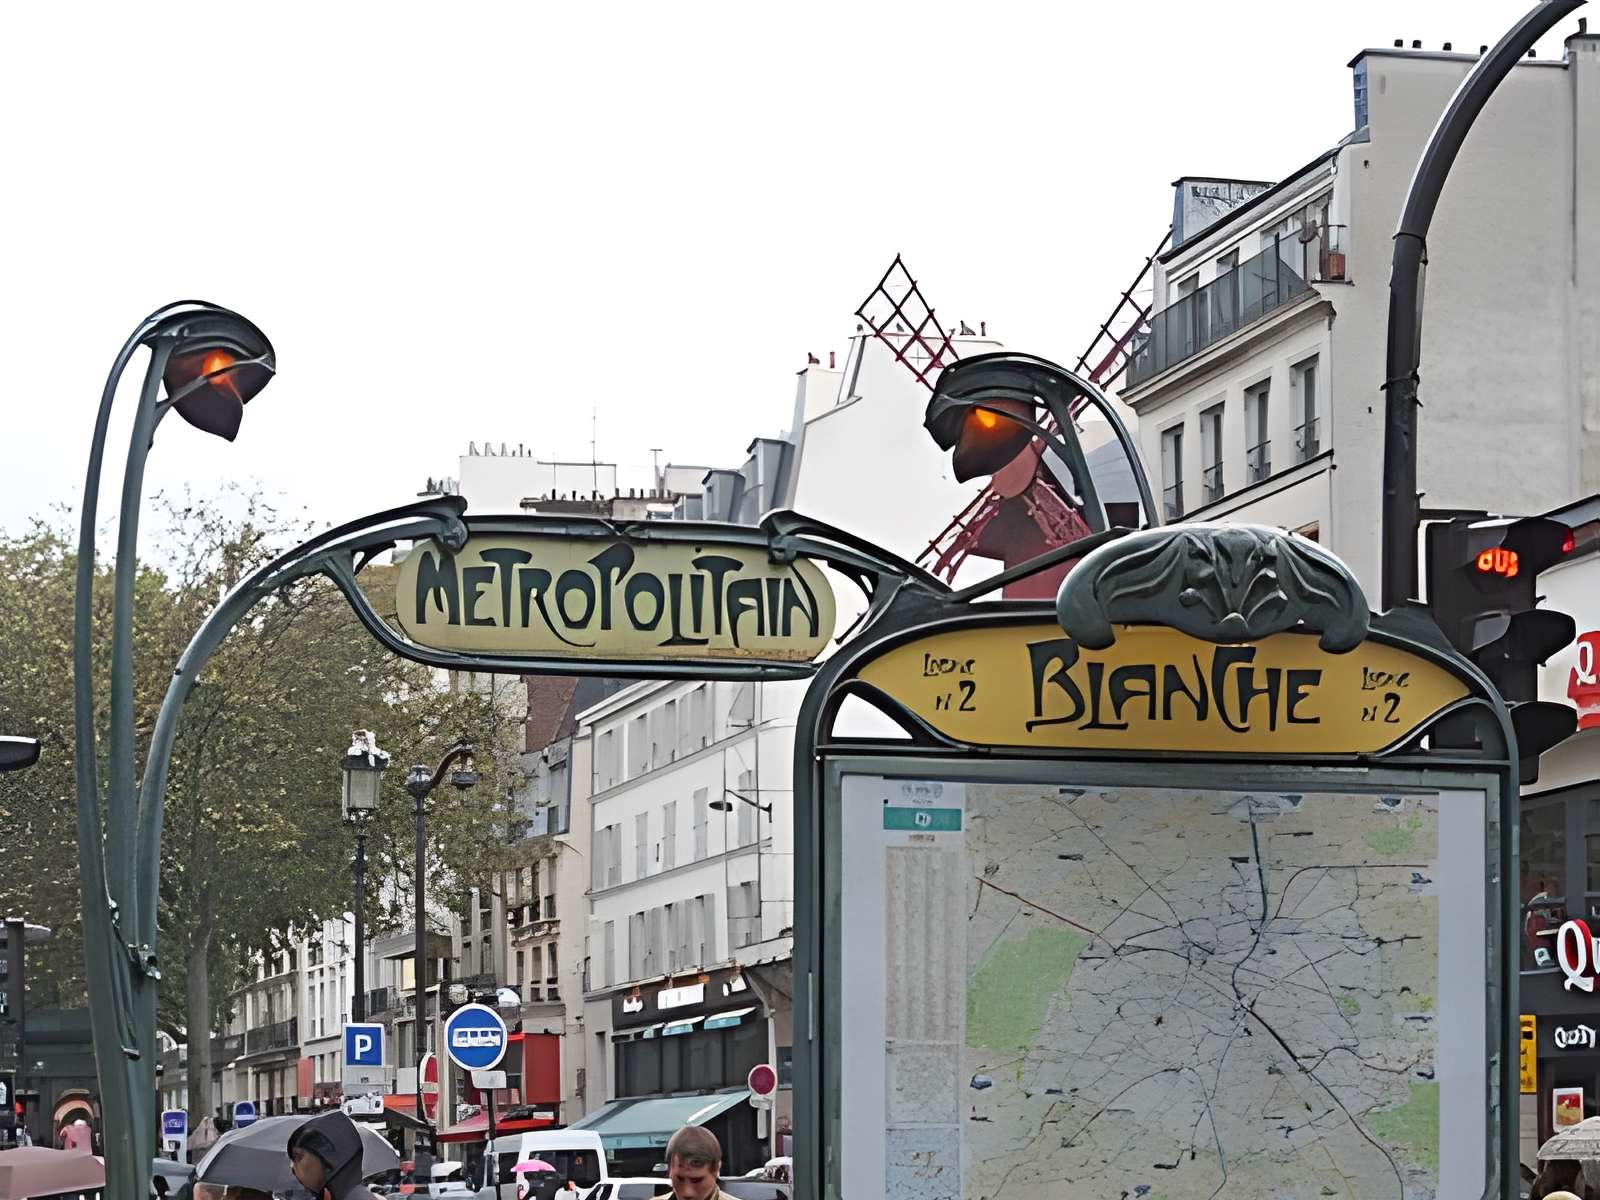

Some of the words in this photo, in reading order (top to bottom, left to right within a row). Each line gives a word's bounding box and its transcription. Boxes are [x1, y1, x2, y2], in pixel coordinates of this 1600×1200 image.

[416, 542, 820, 649] METROPOLITAIN
[959, 680, 976, 712] 2
[1025, 638, 1322, 733] BLANCHE
[1384, 692, 1401, 723] 2
[354, 1034, 372, 1061] P
